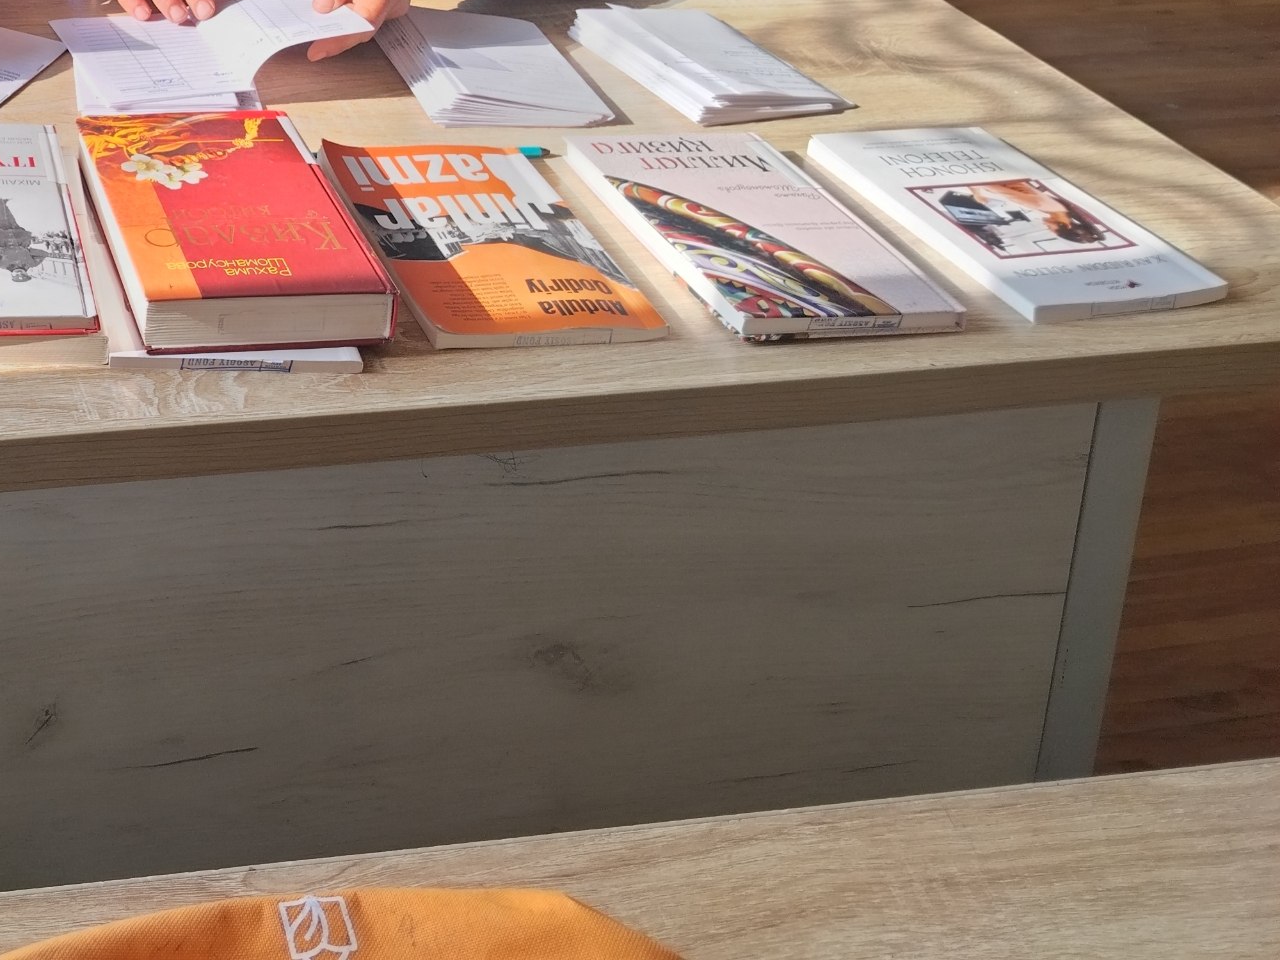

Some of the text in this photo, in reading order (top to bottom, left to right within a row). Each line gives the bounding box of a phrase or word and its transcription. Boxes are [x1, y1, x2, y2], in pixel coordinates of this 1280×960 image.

[879, 150, 990, 166] TELEFONI
[900, 161, 1004, 178] ISHONCH
[166, 257, 289, 271] Шомансурова
[224, 266, 293, 276] Рахима
[524, 278, 613, 295] Qodiriy
[537, 299, 629, 316] Abdulla
